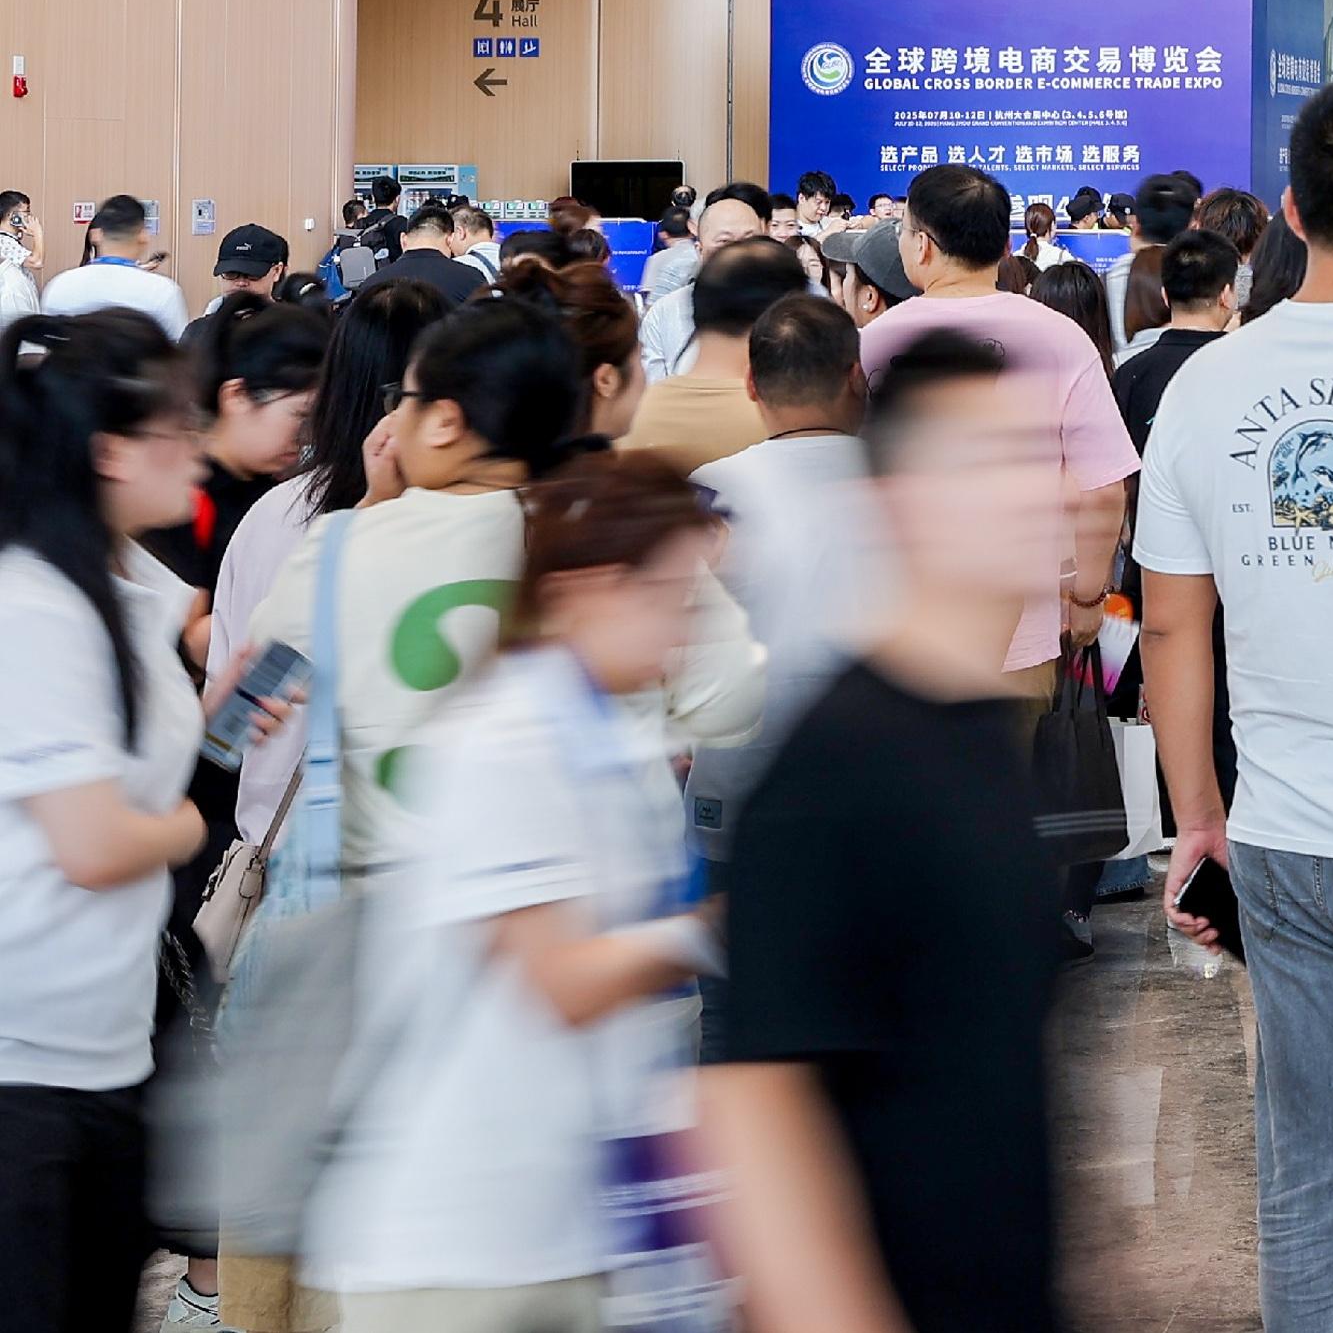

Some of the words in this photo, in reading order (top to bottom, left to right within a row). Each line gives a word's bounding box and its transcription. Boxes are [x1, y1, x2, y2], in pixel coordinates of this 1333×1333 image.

[511, 15, 537, 27] Hall
[865, 46, 1223, 75] 全球跨境电商交易博览会
[865, 77, 920, 90] GLOBAL
[924, 77, 971, 90] CROSS
[975, 77, 1033, 89] BORDER
[1038, 77, 1131, 89] E-COMMERCE
[1135, 77, 1181, 89] TRADE
[1185, 76, 1222, 89] EXPO
[881, 145, 938, 164] 选产品
[948, 145, 1006, 163] 选人才
[1015, 145, 1073, 163] 选市场
[1082, 145, 1140, 163] 选服务
[1229, 387, 1302, 470] ANTA
[1232, 503, 1254, 513] EST.
[1268, 535, 1316, 551] BLUE
[1241, 553, 1314, 567] GREEN
